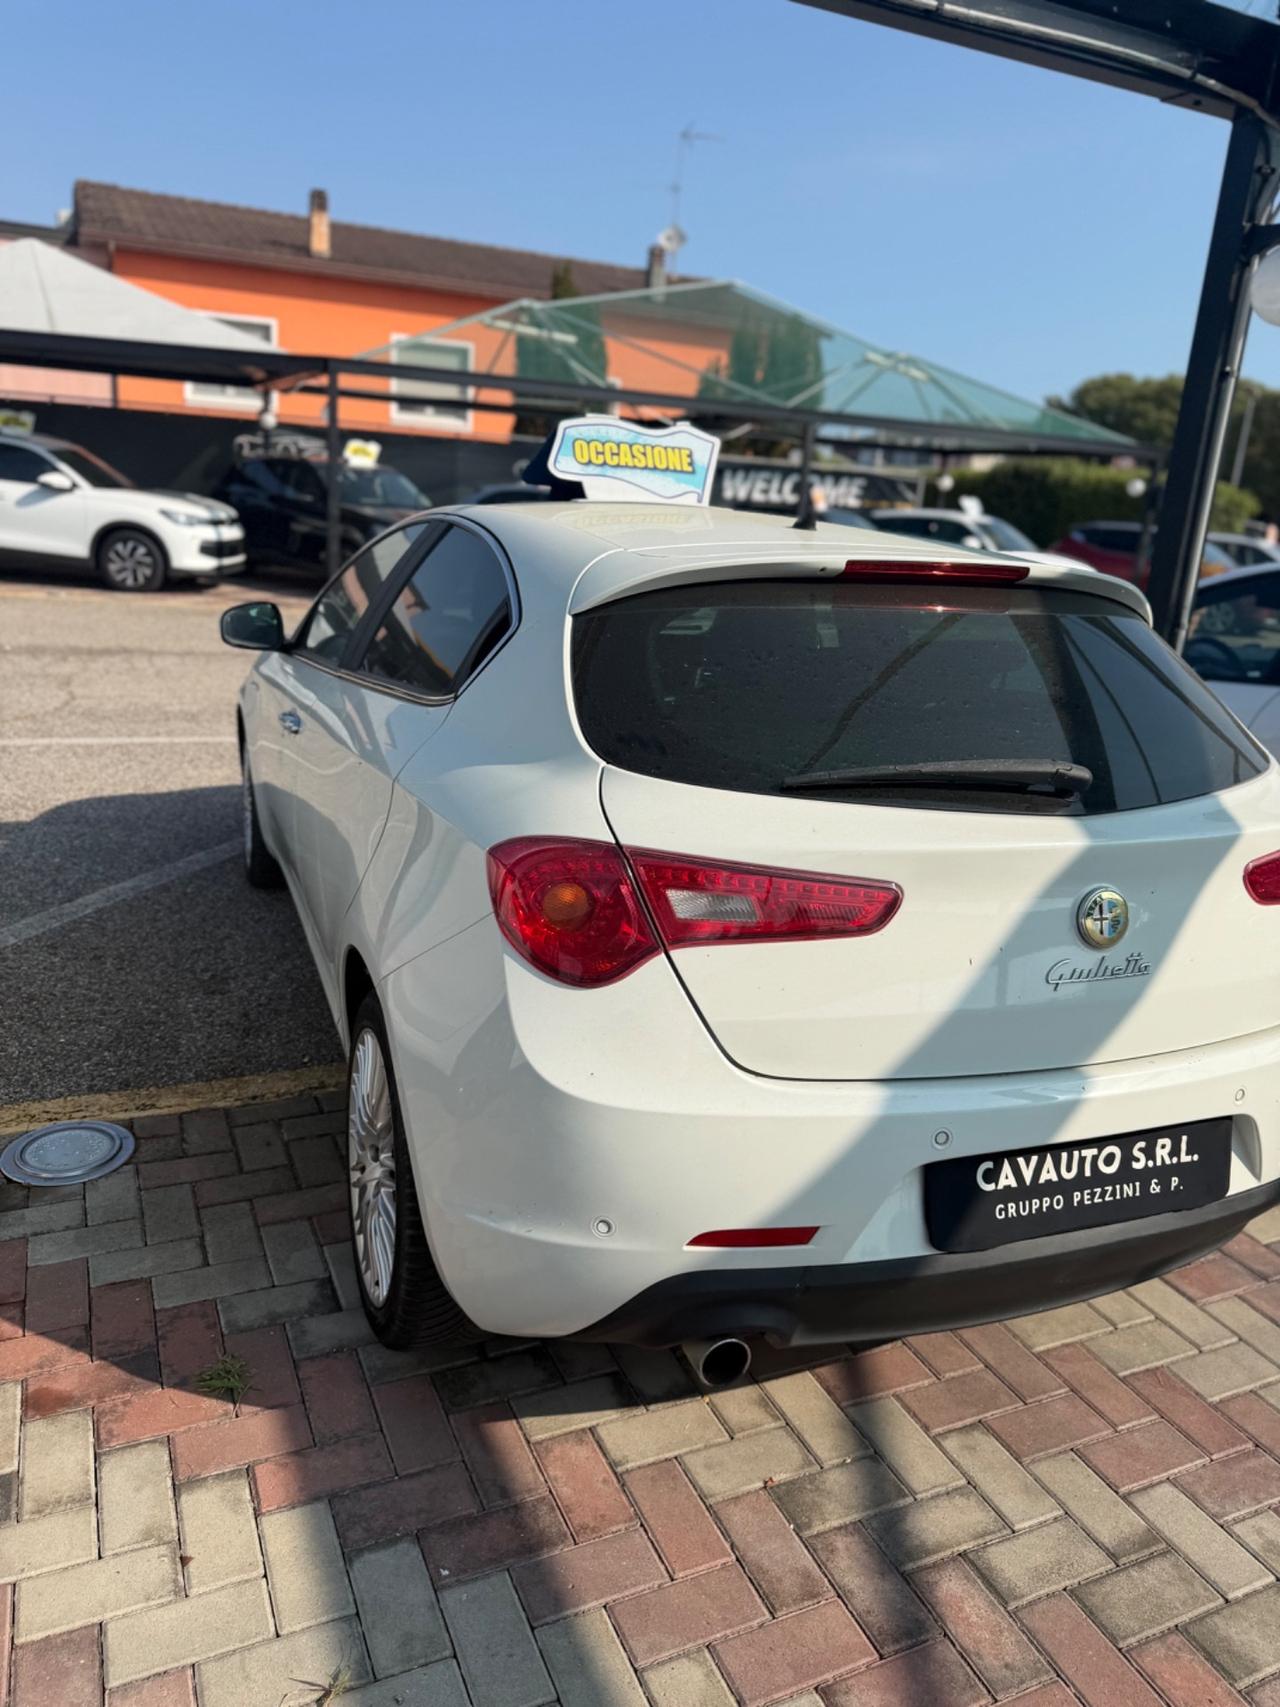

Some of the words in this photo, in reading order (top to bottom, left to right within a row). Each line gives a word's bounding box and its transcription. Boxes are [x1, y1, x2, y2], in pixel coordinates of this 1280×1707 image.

[572, 438, 695, 474] OCCASIONE
[721, 468, 867, 508] WELCME
[1045, 952, 1152, 992] Giulietta
[975, 1145, 1121, 1192] CAVAUTO
[1131, 1134, 1199, 1170] S.R.L.
[995, 1194, 1065, 1220] GRUPPO
[1072, 1181, 1141, 1207] PEZZINI
[1149, 1178, 1162, 1194] &
[1170, 1176, 1185, 1192] P.
